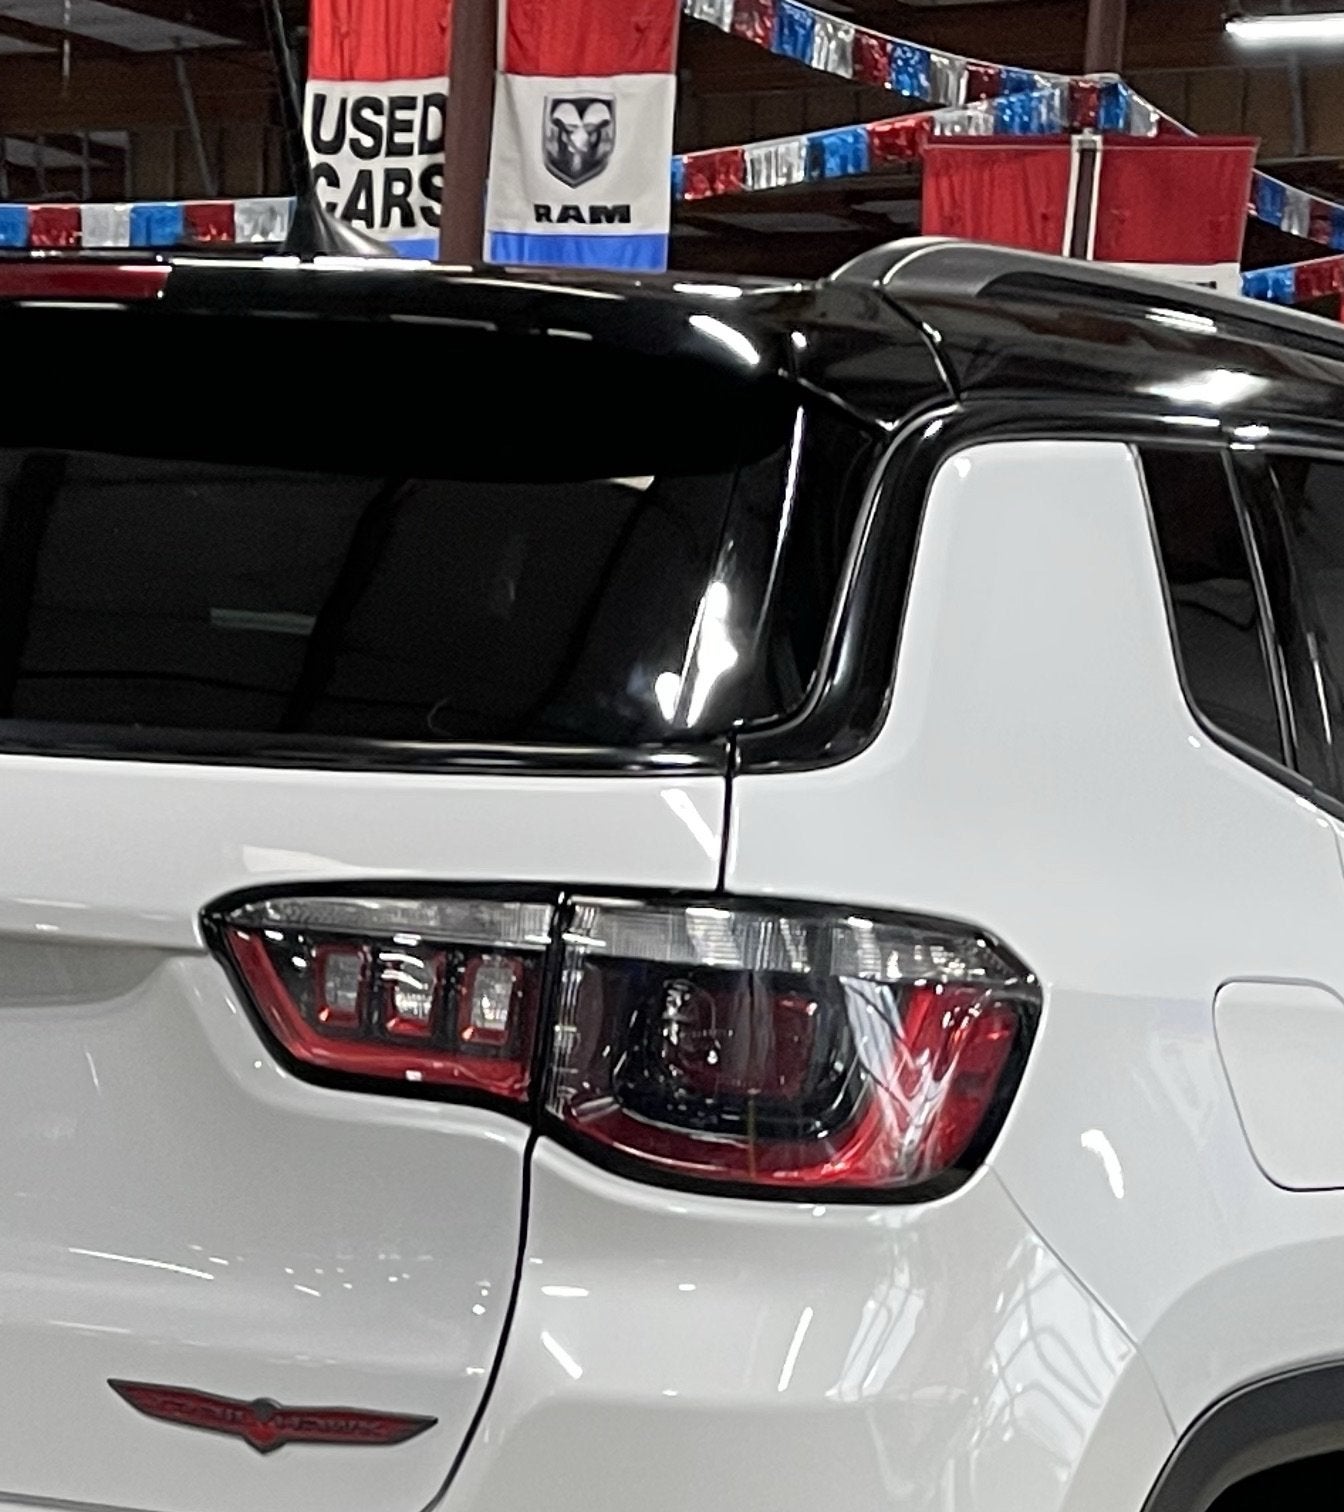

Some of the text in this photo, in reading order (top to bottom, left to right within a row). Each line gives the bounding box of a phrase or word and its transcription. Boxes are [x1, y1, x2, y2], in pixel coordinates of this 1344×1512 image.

[310, 93, 446, 160] USED
[312, 162, 443, 229] CARS
[533, 203, 632, 224] RAM
